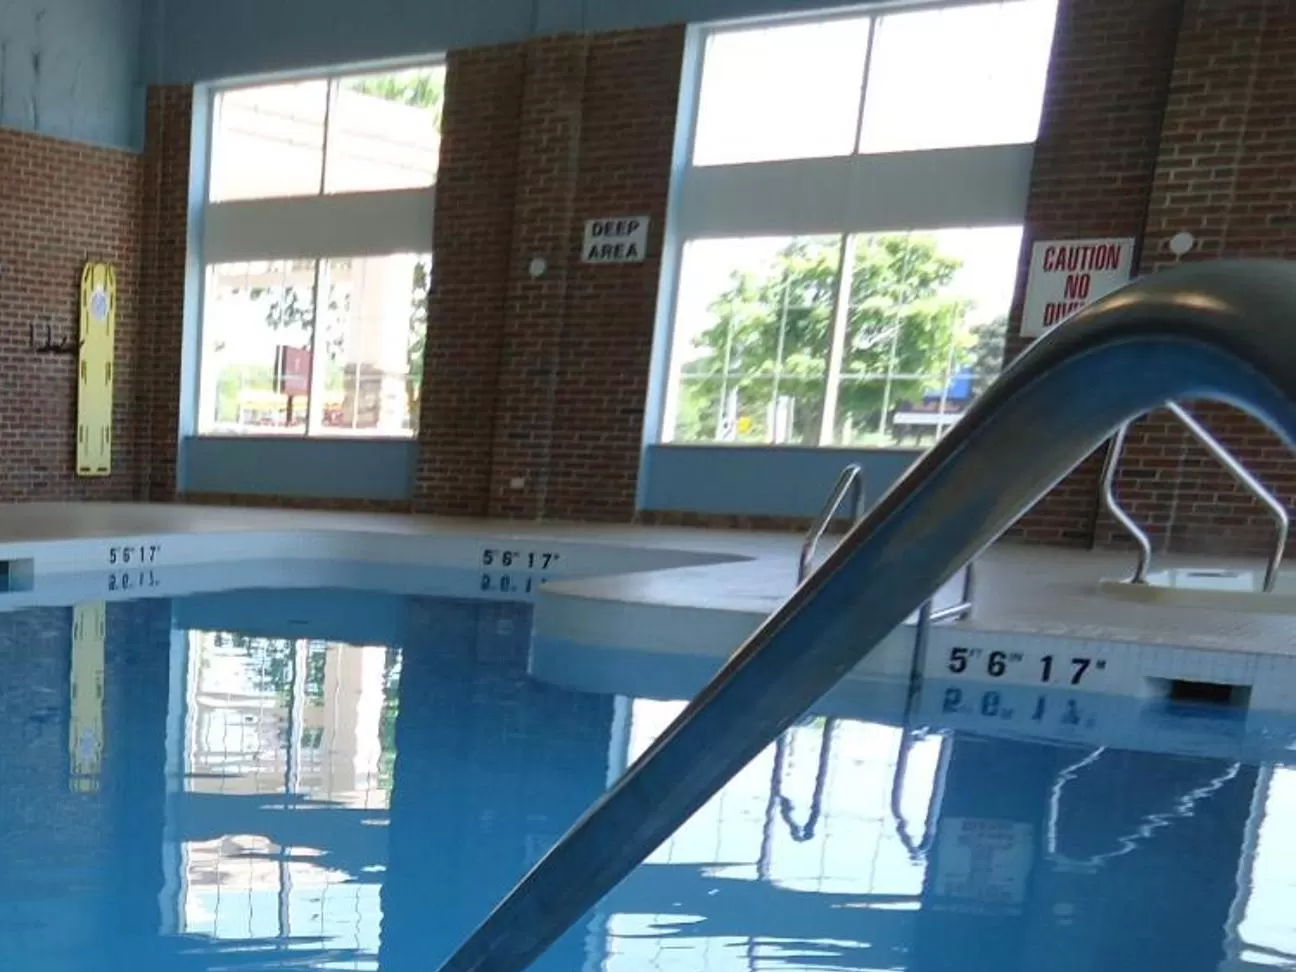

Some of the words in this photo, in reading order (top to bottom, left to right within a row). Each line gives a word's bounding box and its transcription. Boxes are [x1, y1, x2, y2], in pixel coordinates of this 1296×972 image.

[591, 221, 640, 237] DEEP
[588, 243, 638, 260] AREA
[1044, 243, 1121, 272] CAUTION
[1065, 273, 1091, 299] NO
